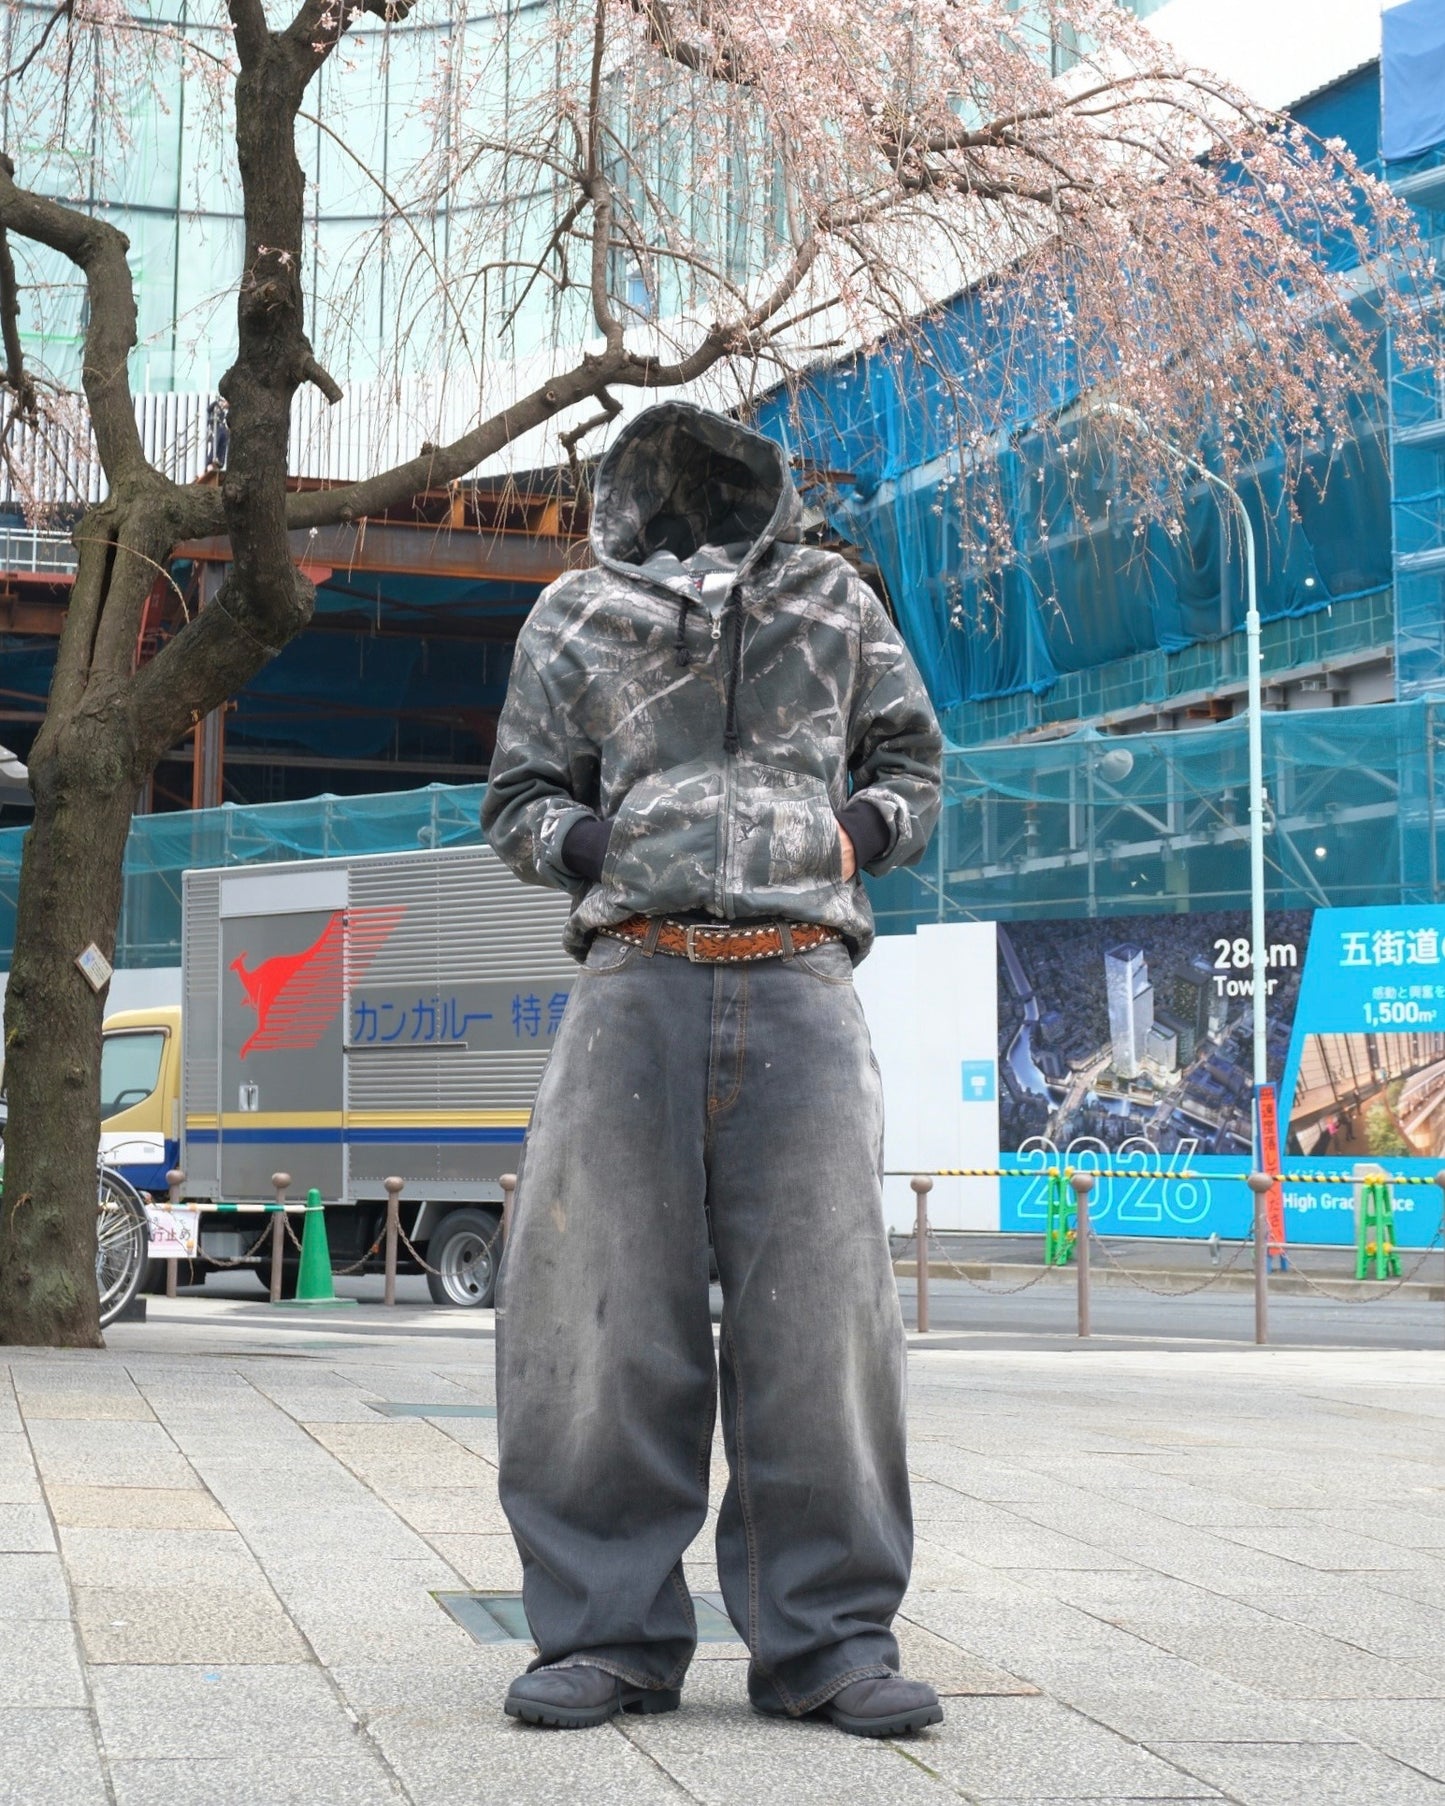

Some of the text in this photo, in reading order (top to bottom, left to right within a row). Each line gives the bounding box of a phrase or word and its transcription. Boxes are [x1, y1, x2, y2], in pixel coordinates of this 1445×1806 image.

[1339, 928, 1445, 967] 五街道
[1213, 975, 1278, 997] Towr
[354, 997, 493, 1042] カンガルー
[1016, 1136, 1212, 1224] 2026
[1283, 1193, 1317, 1213] High
